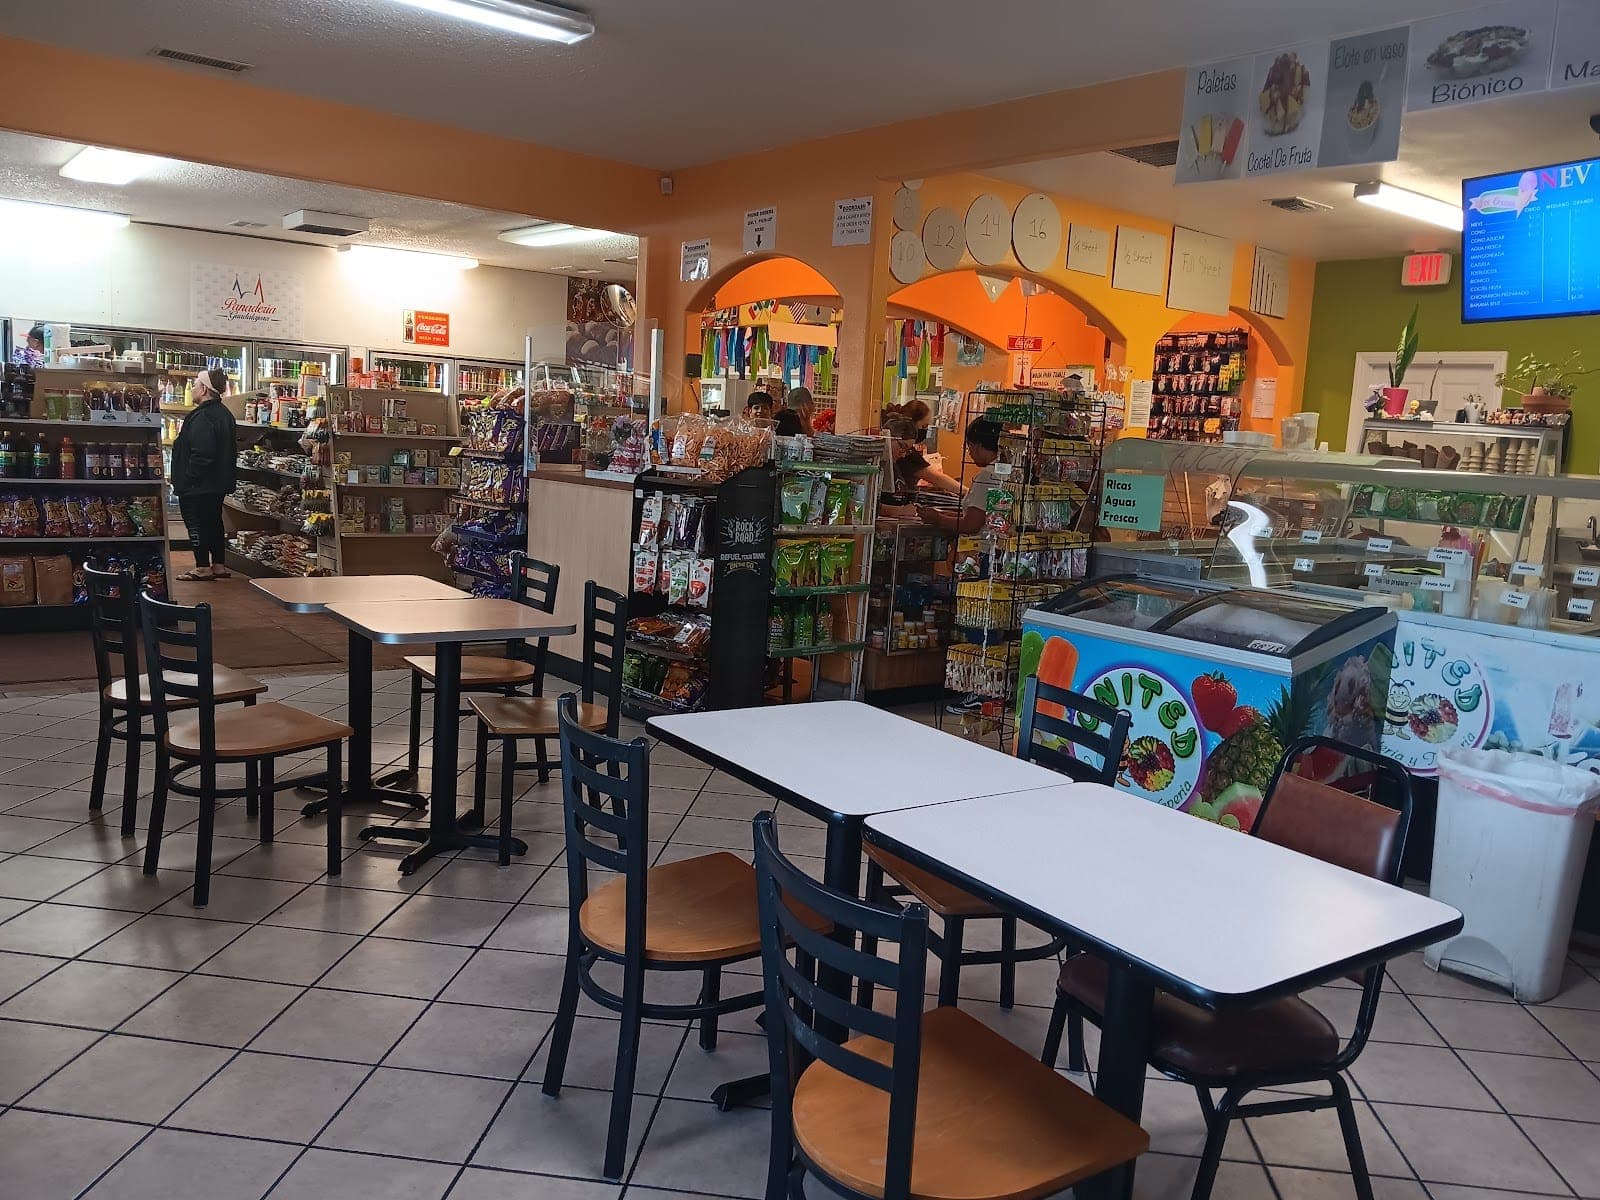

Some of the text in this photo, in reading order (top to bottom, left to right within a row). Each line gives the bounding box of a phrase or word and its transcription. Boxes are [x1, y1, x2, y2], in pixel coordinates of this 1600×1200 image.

[1334, 42, 1405, 70] Elote en vaso
[1197, 69, 1237, 95] Paletas
[1431, 76, 1524, 104] Biónico
[1247, 145, 1313, 172] Coctel De Fruta
[933, 224, 956, 250] 12
[979, 212, 1000, 237] 14
[1028, 218, 1047, 240] 16
[1408, 255, 1444, 283] EXIT
[1106, 479, 1132, 491] Ricas
[1104, 495, 1137, 508] Aguas
[735, 521, 754, 532] ROCK
[1102, 510, 1139, 524] Frescas
[735, 532, 754, 543] ROAD
